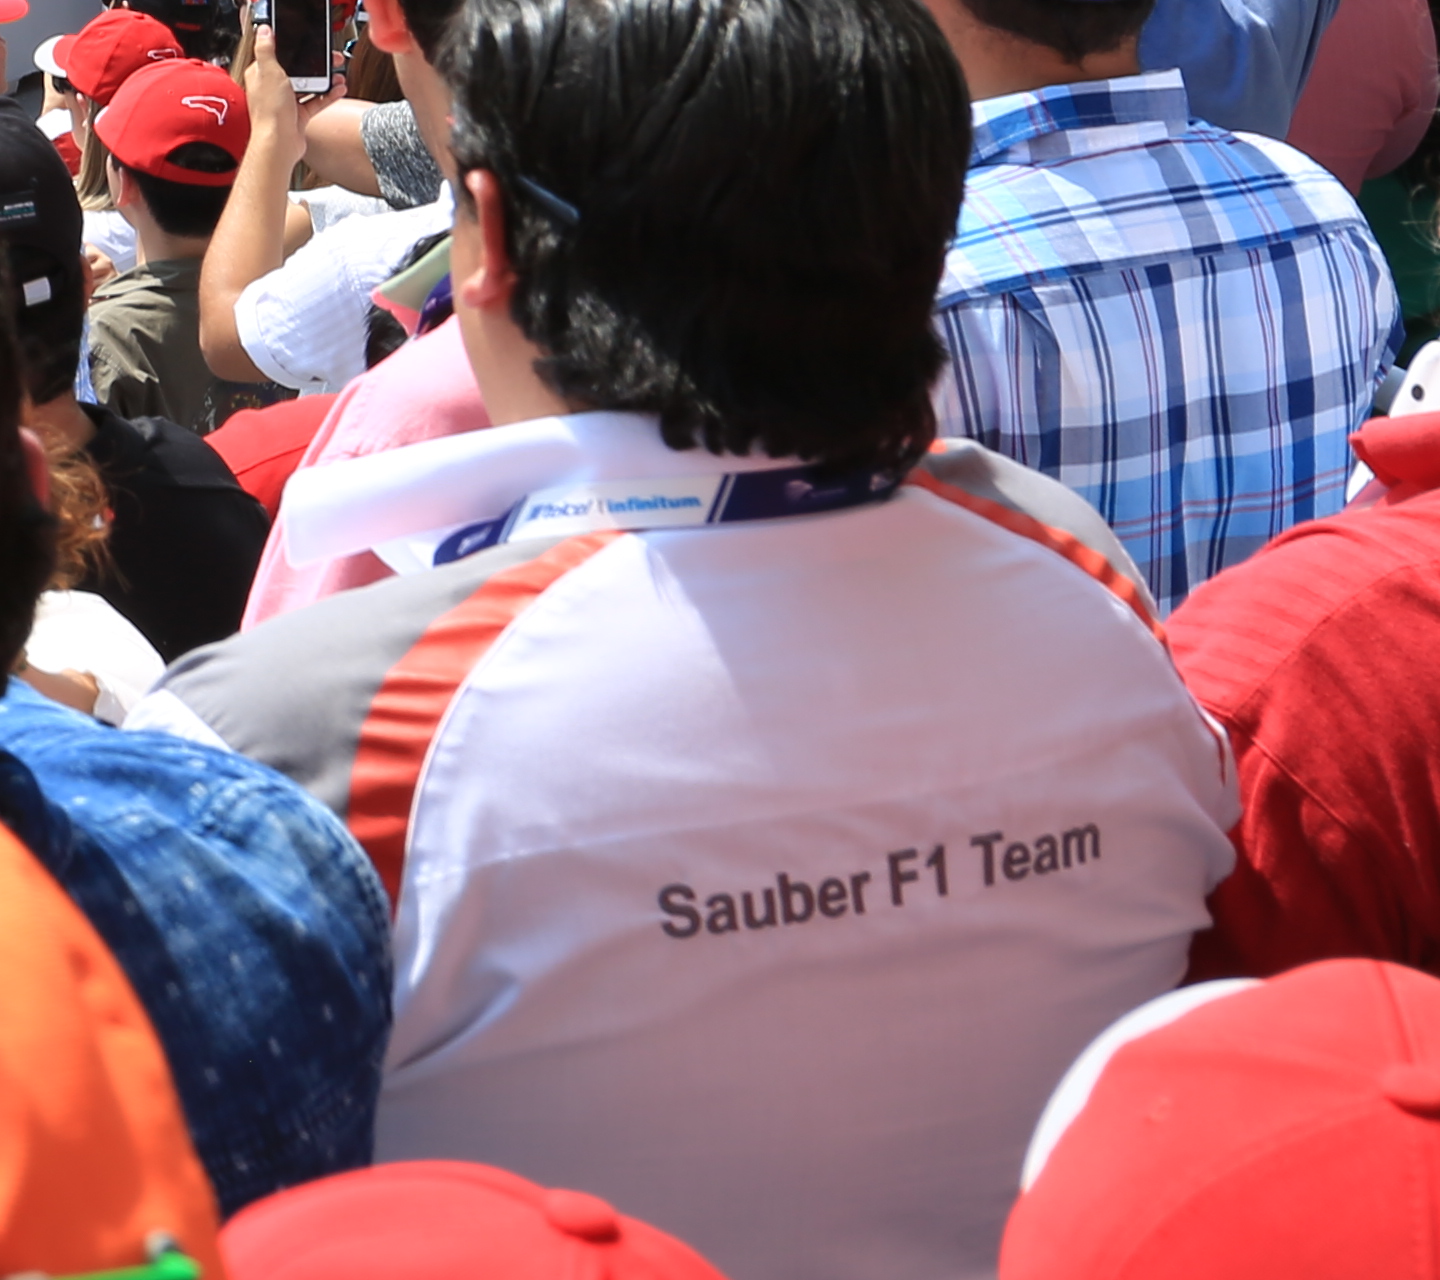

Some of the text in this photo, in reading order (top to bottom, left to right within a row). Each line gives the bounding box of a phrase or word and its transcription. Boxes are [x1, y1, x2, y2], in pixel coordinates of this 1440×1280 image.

[606, 494, 702, 516] infinitum
[657, 822, 1101, 938] Sauber F1 Team
